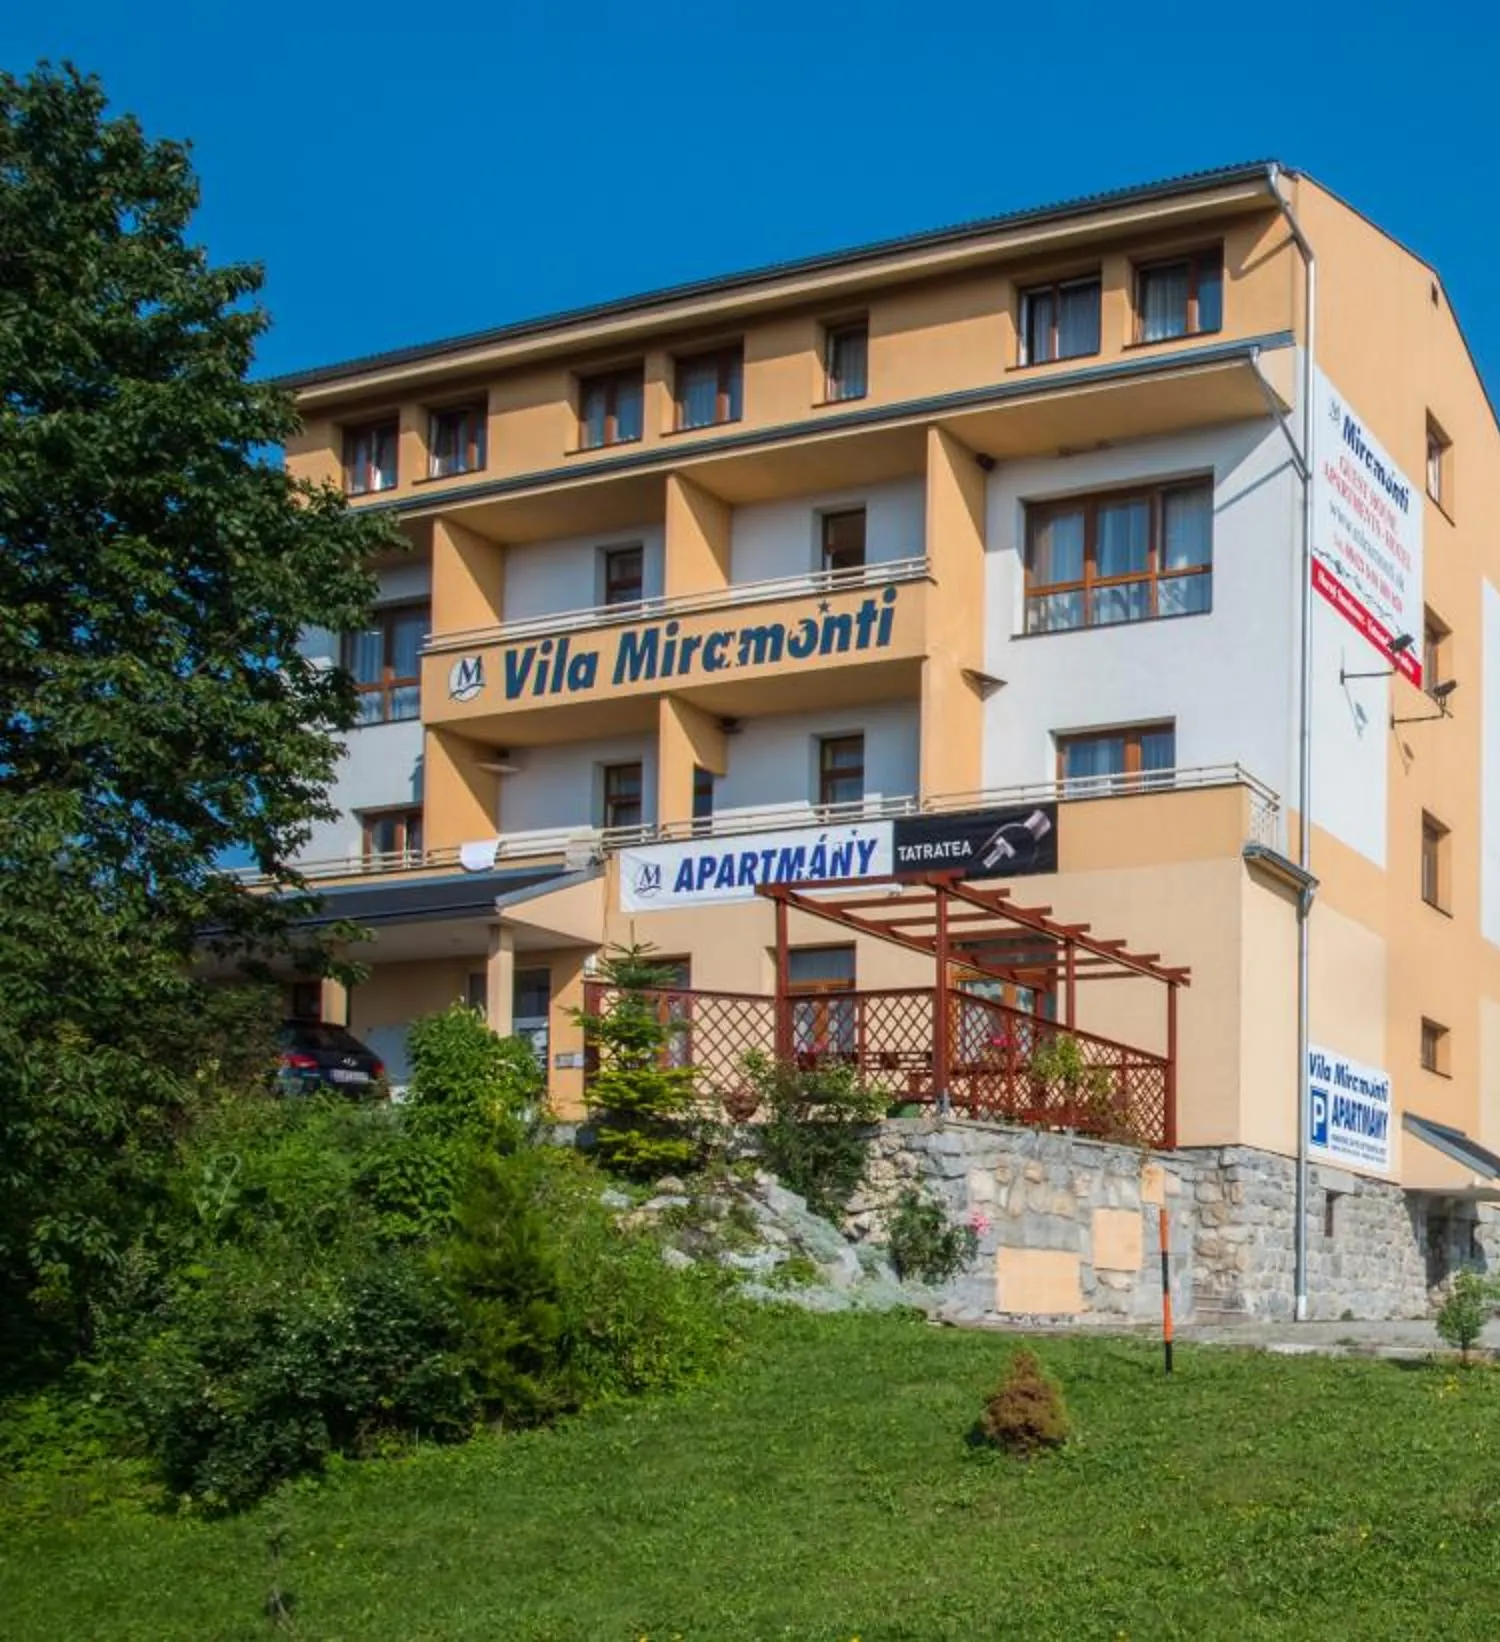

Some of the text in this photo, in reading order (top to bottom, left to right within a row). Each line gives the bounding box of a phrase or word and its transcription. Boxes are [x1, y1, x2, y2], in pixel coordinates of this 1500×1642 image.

[504, 585, 898, 699] Vila Miramonti
[673, 833, 878, 893] APARTMÁNY
[897, 839, 972, 862] TATRATEA
[1309, 1052, 1331, 1082] Vila
